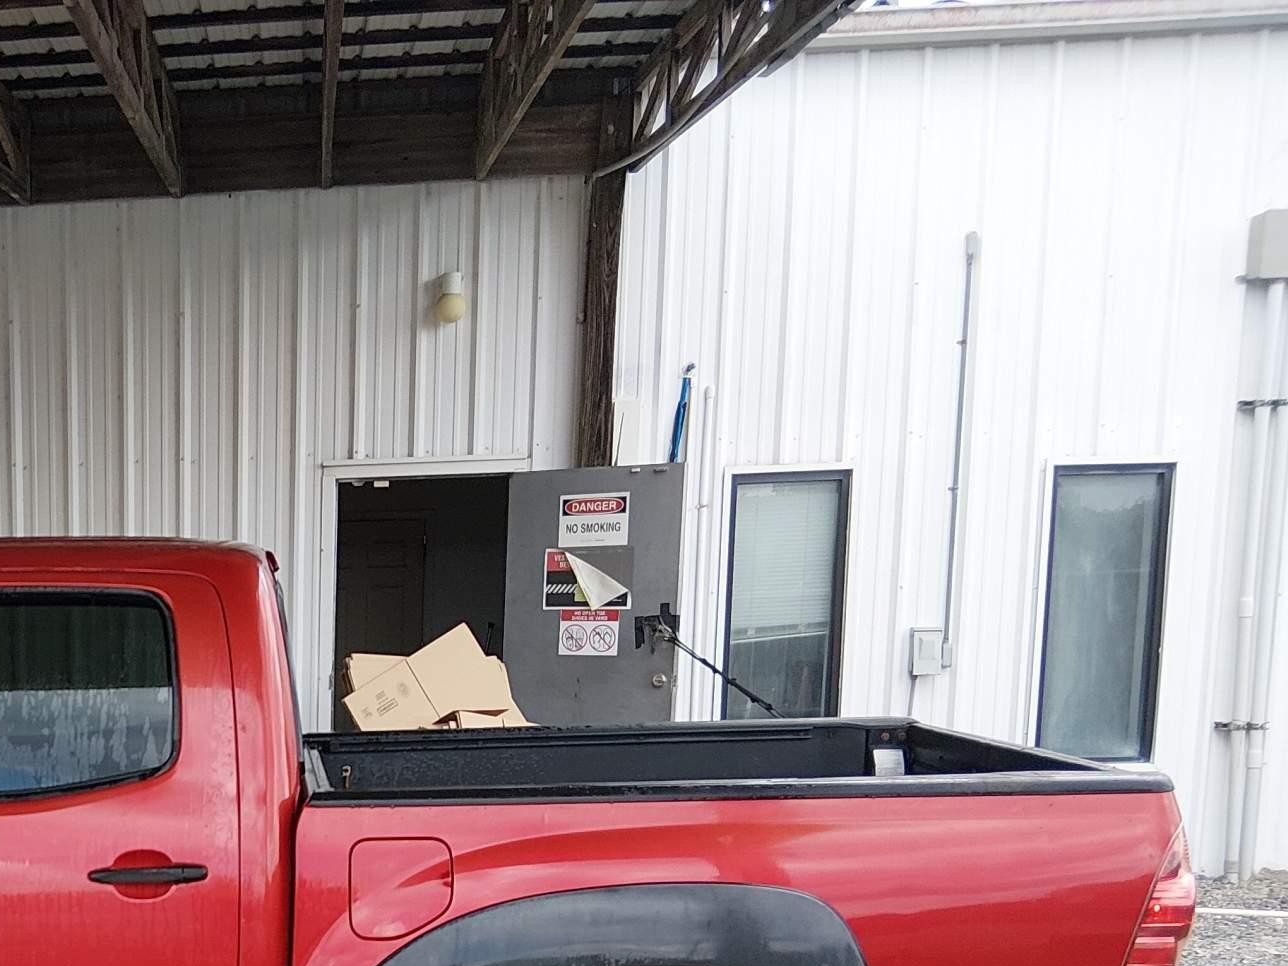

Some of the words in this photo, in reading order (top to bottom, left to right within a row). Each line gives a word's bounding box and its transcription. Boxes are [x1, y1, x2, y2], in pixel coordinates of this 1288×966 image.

[572, 501, 617, 512] DANGER
[566, 523, 578, 533] NO
[581, 522, 621, 533] SMOKING
